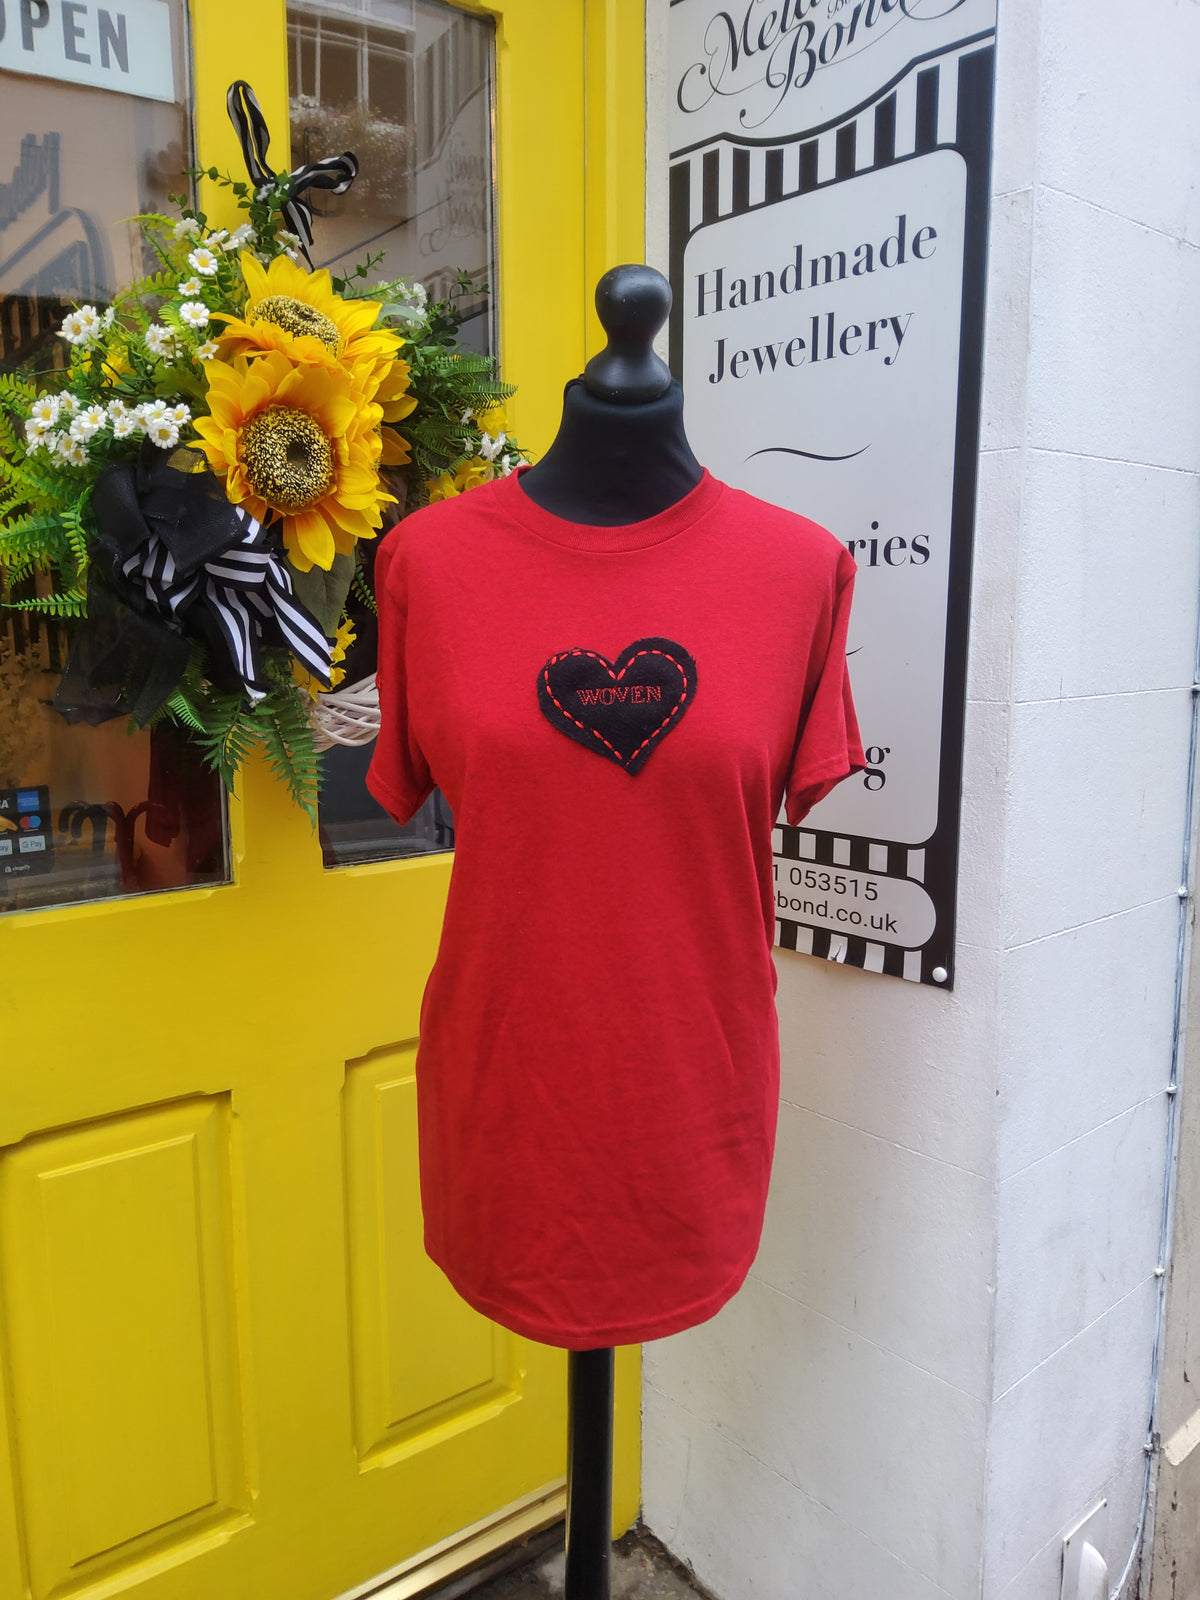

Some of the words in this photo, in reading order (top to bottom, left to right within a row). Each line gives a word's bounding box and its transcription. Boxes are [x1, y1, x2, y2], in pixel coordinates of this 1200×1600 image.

[0, 0, 129, 73] PEN
[694, 214, 937, 318] Handmade
[708, 312, 915, 384] Jewellery
[576, 685, 662, 706] WOVEN
[774, 890, 898, 933] bond.co.uk
[790, 867, 878, 901] 053515
